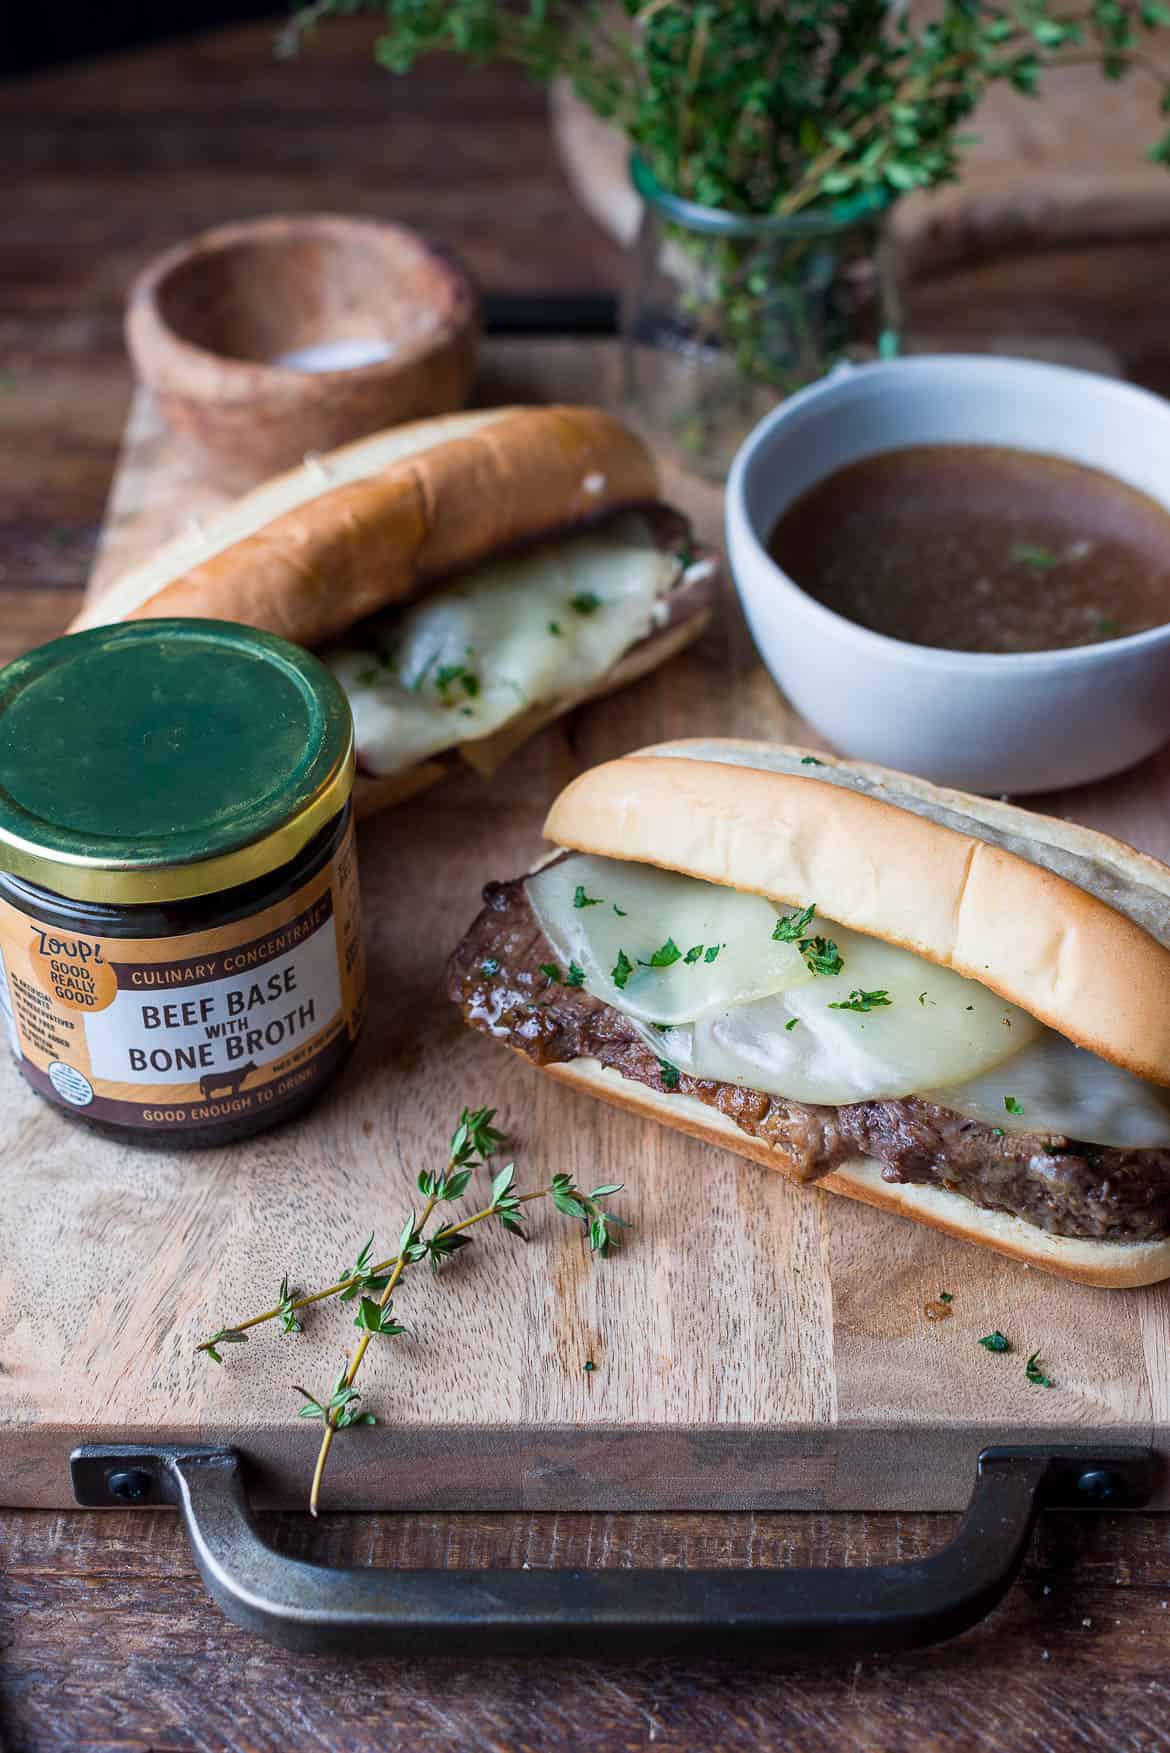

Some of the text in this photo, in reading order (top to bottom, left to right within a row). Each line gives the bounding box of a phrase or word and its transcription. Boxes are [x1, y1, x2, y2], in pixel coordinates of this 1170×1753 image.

[30, 925, 104, 964] Zoup!
[131, 962, 217, 985] CULINARY
[223, 908, 321, 971] CONCENTRATE
[50, 959, 94, 981] GOOD,
[50, 970, 96, 994] REALLY
[141, 966, 298, 1030] BEEF BASE
[128, 1043, 215, 1073] BONE
[225, 999, 315, 1061] BROTH
[204, 1017, 249, 1040] WITH
[142, 1110, 186, 1122] GOOD
[191, 1098, 251, 1121] ENOUGH
[256, 1088, 274, 1103] TO
